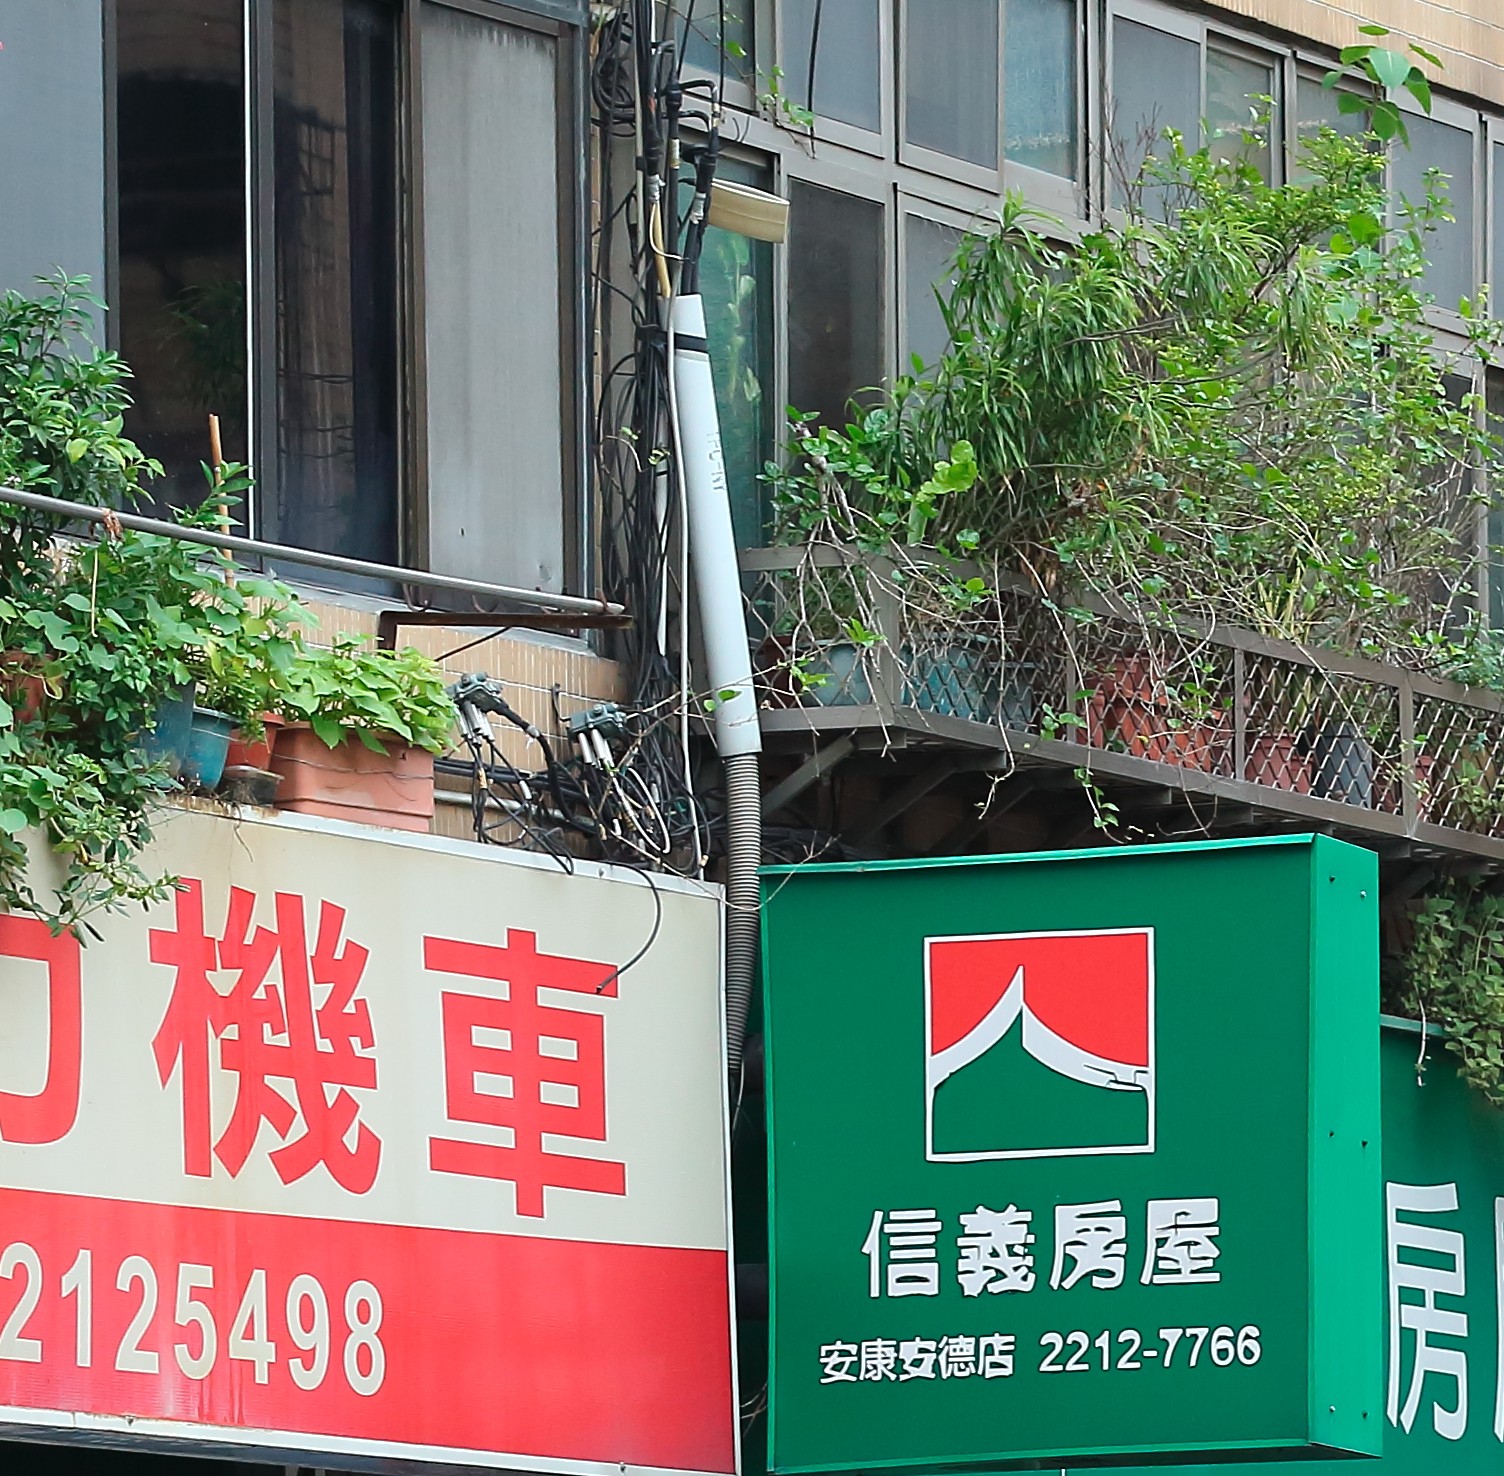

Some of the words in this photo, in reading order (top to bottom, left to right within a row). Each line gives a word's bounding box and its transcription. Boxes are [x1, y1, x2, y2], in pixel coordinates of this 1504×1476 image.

[861, 1197, 1220, 1298] 信義房屋
[0, 1242, 386, 1397] 2125498
[1039, 1325, 1262, 1373] 2212-7766
[819, 1332, 1016, 1384] 安康安德店
